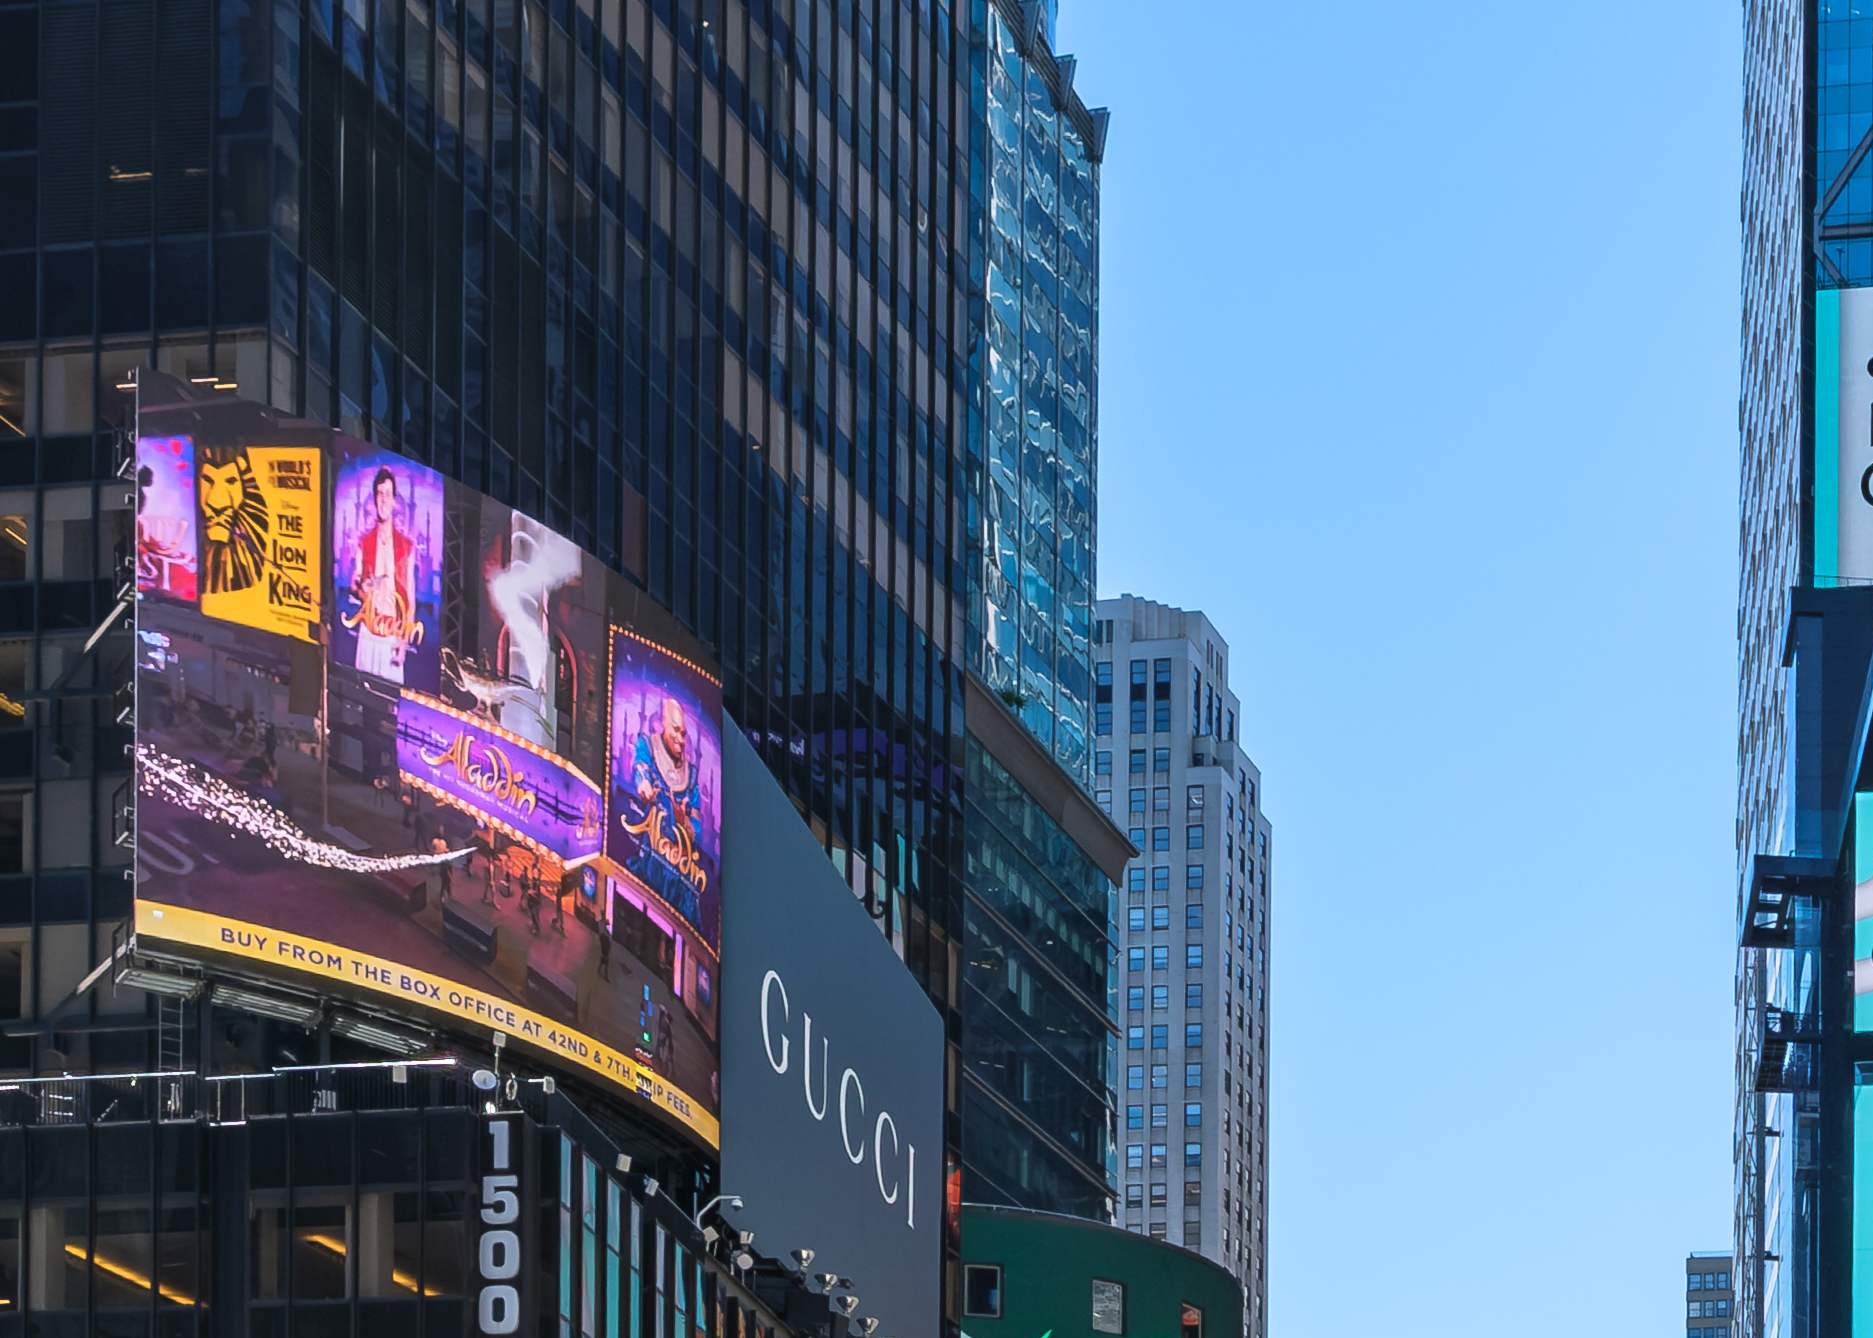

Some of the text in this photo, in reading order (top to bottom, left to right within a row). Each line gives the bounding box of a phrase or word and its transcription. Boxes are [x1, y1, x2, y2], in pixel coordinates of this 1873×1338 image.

[271, 539, 307, 567] LION
[277, 513, 304, 534] THE
[268, 572, 313, 607] KING
[419, 730, 537, 816] Aladdin
[620, 806, 708, 893] Aladdin
[220, 928, 267, 951] BUY
[278, 941, 343, 971] FROM
[351, 959, 393, 986] THE
[400, 975, 441, 1001] BOX
[448, 991, 516, 1028] OFFICE
[521, 1018, 544, 1038] AT
[547, 1029, 589, 1058] 42ND
[593, 1049, 602, 1065] &
[760, 970, 915, 1230] GUCCI
[478, 1120, 520, 1335] 1500
